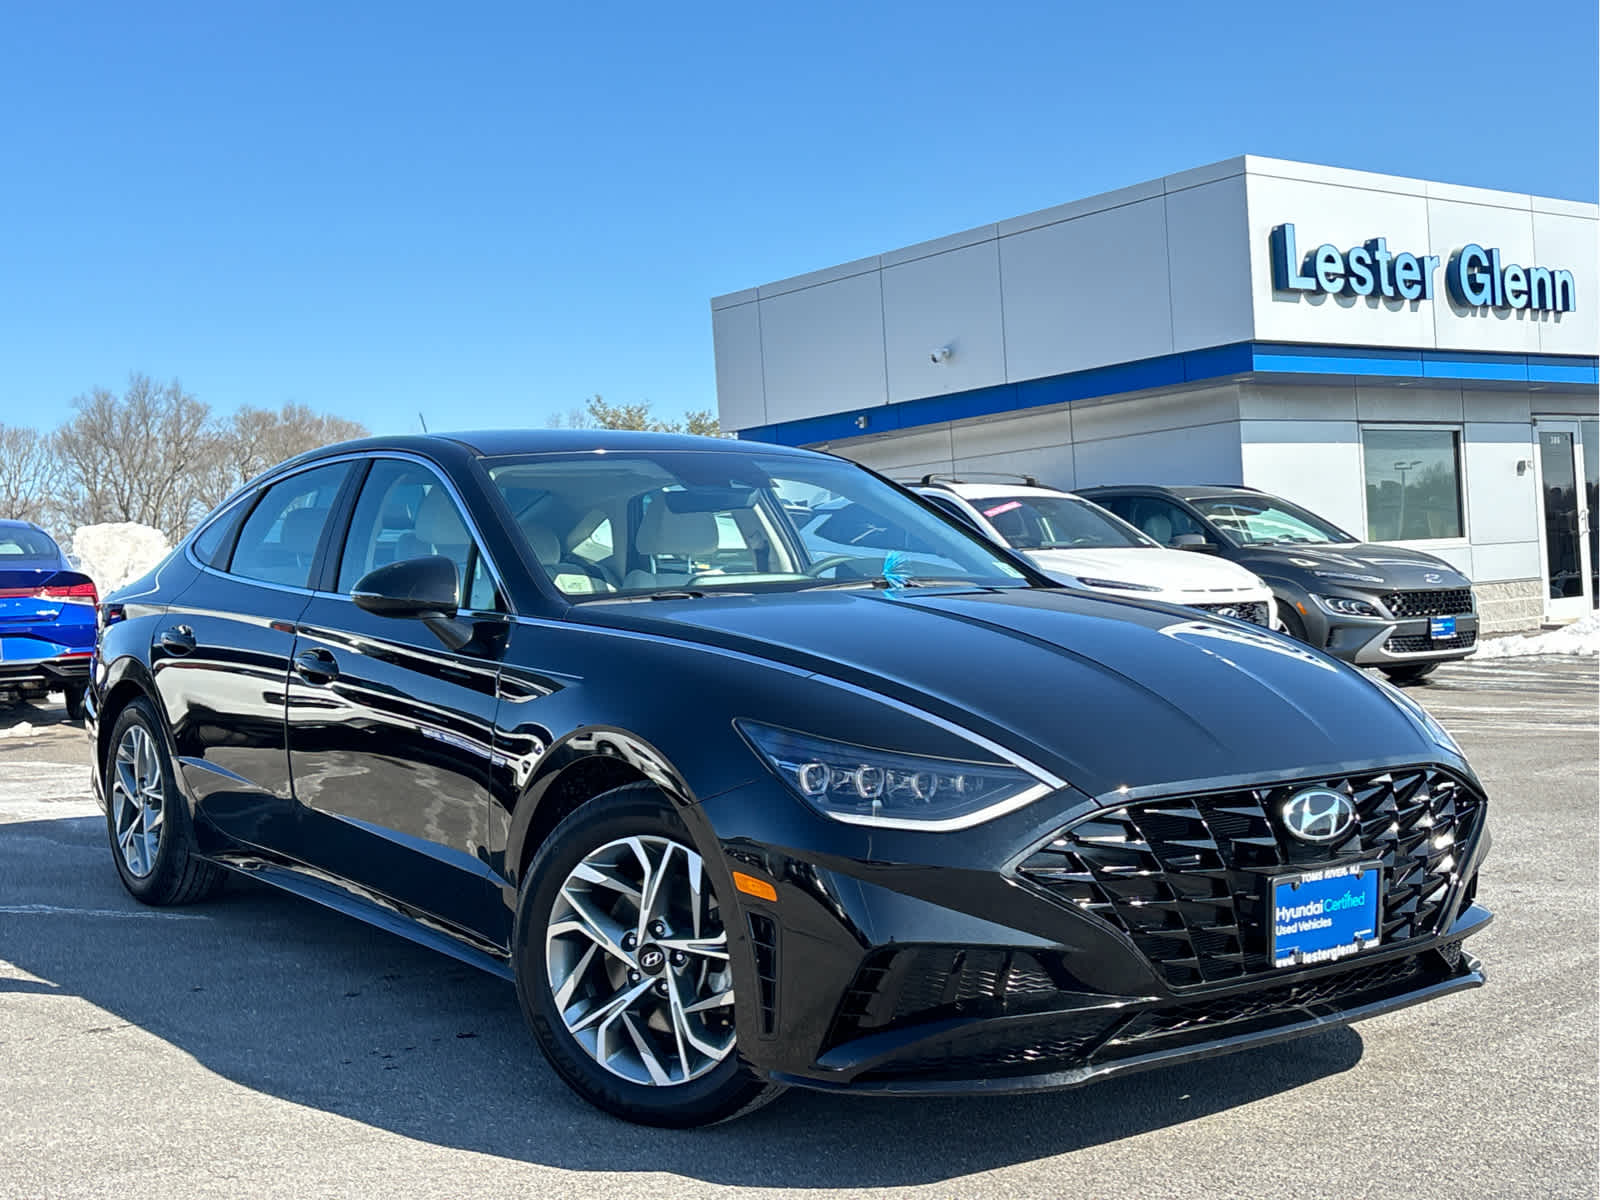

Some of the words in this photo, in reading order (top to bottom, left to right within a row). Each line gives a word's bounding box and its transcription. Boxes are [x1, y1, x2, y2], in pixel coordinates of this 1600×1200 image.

[1270, 223, 1440, 300] Lester
[1447, 243, 1576, 312] Glenn
[1301, 871, 1323, 883] TOMS
[1350, 864, 1360, 875] NJ
[1275, 899, 1324, 923] Hyundai
[1324, 889, 1366, 912] Certified
[1275, 922, 1298, 936] Used
[1298, 917, 1333, 932] Vehicles
